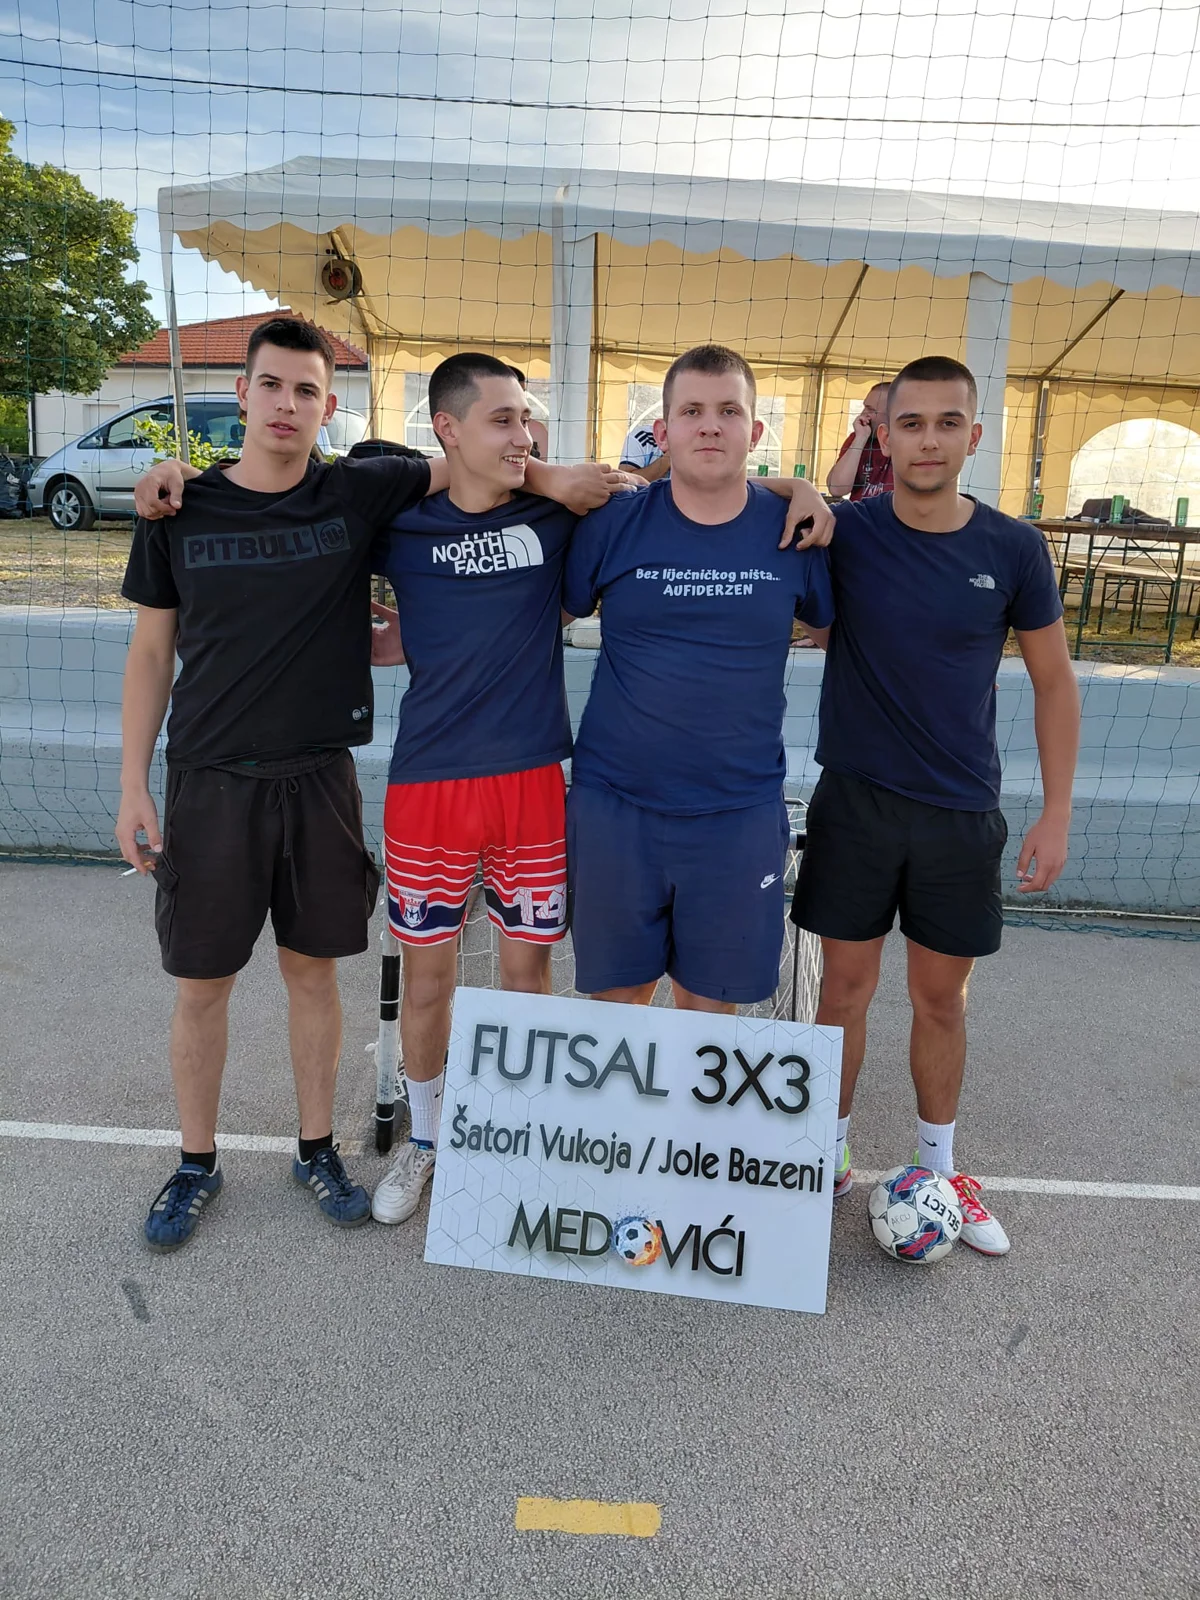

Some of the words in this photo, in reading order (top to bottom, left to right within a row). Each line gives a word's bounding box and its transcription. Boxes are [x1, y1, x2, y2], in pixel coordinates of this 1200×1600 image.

[187, 532, 313, 563] PITBULL
[432, 536, 504, 564] NORTH
[454, 554, 507, 575] FACE
[635, 568, 659, 580] Bez
[662, 568, 737, 583] liječničkog
[663, 583, 753, 597] AUFIDERZEN
[470, 1023, 670, 1097] FUTSAL
[691, 1045, 812, 1115] 3X3
[450, 1104, 531, 1157] Šatori
[539, 1123, 632, 1174] Vukoja
[638, 1137, 656, 1174] /
[658, 1139, 719, 1180] Jole
[728, 1147, 824, 1193] Bazeni
[922, 1194, 960, 1232] SELECT
